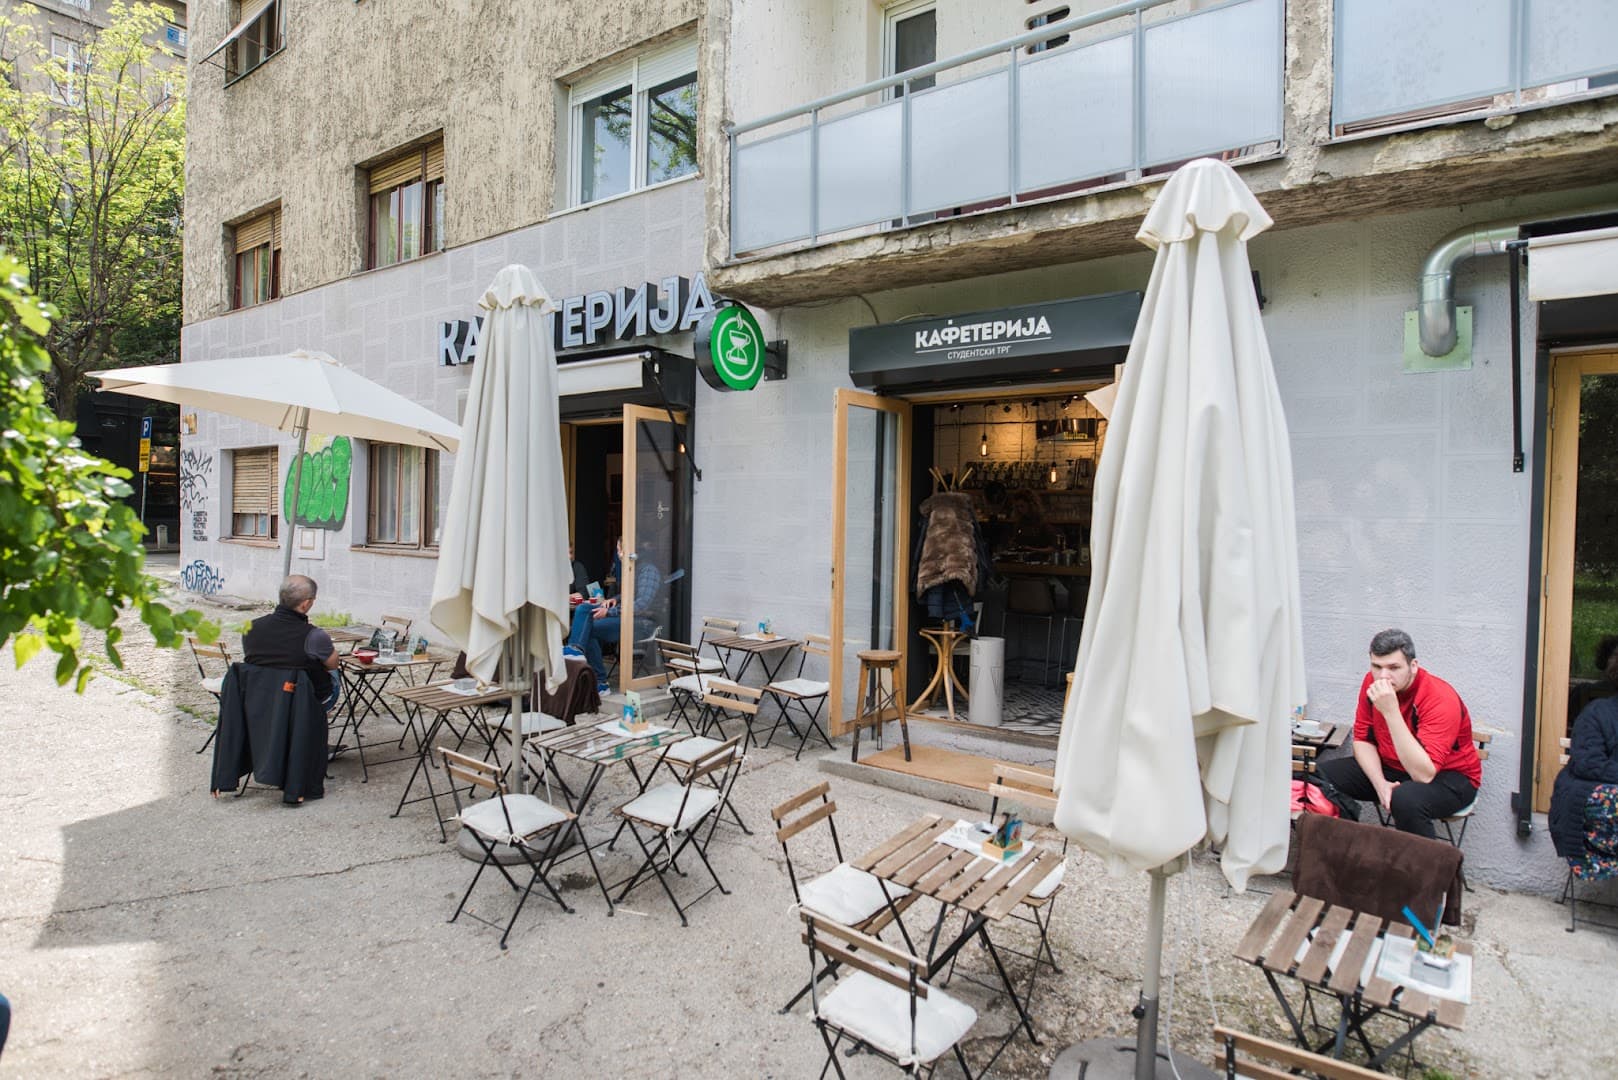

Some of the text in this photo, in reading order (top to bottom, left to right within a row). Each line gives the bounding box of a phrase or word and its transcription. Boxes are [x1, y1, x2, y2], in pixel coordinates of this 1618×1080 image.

[439, 271, 716, 366] КАЕРИЈА
[915, 315, 1052, 349] КАФЕТЕРИЈА
[947, 345, 1012, 360] СТУДЕНТСКИ ТРГ
